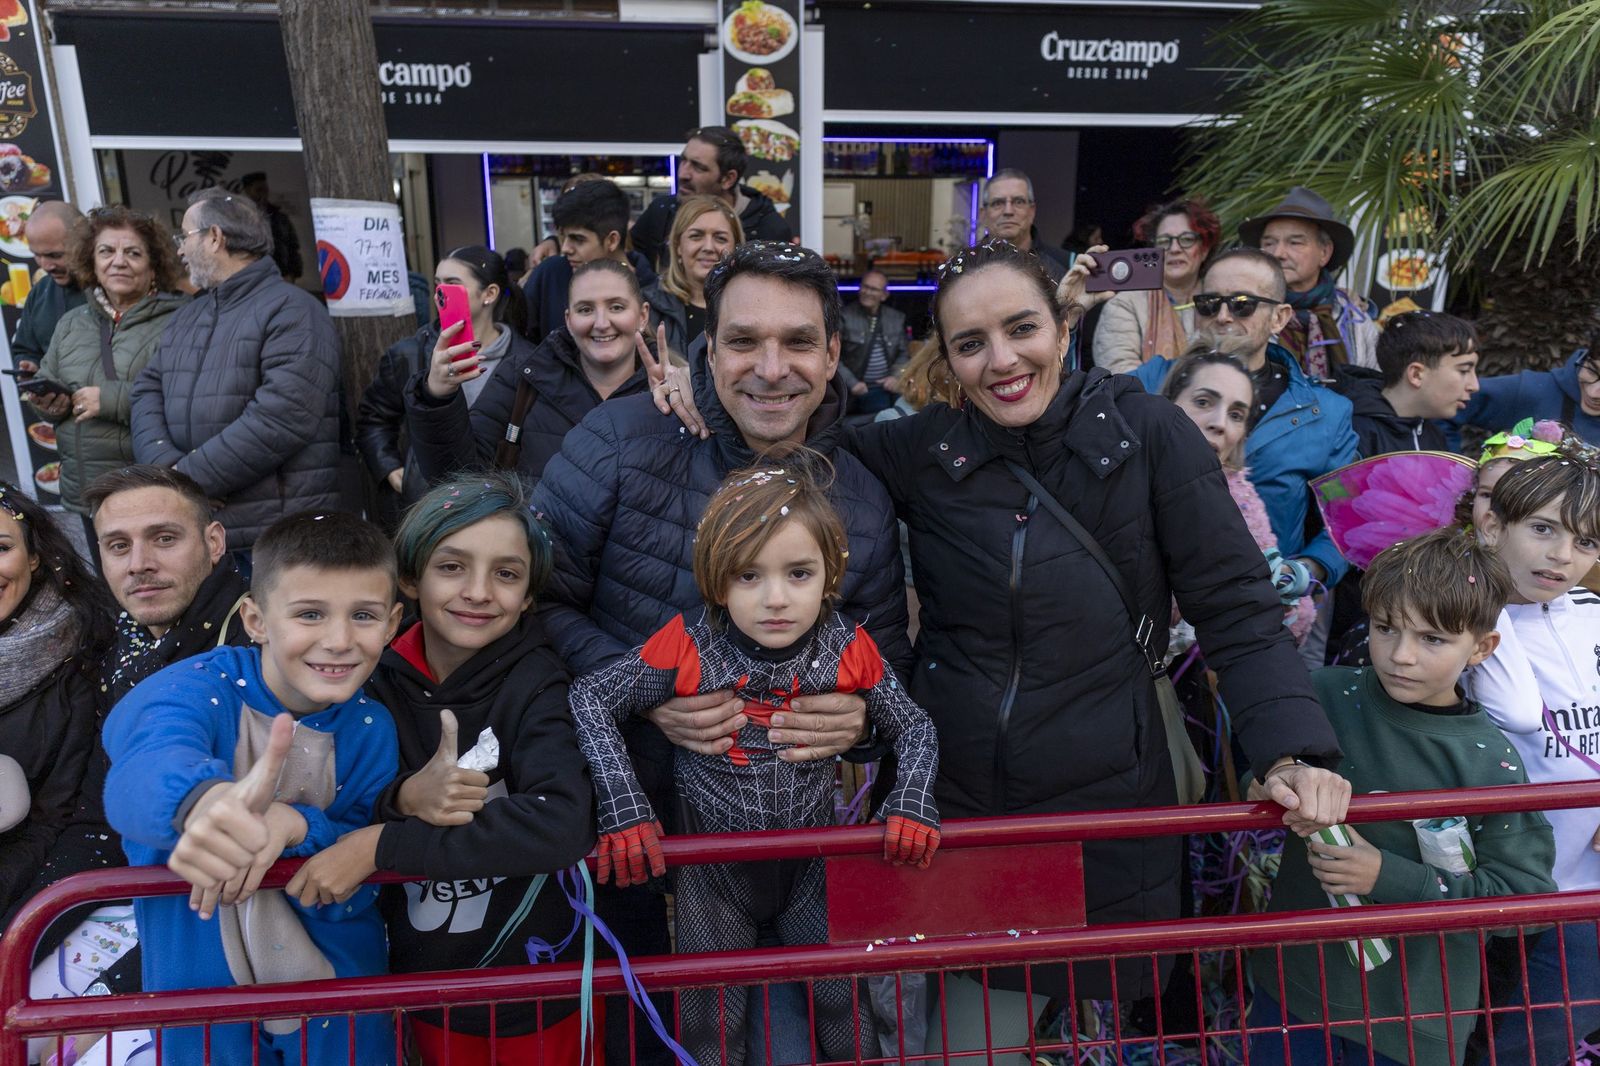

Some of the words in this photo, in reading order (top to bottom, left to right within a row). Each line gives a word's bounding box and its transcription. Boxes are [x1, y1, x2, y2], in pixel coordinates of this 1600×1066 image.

[1041, 31, 1179, 67] Cruzcampo
[378, 60, 471, 91] campo
[1067, 67, 1108, 79] DESDE
[364, 217, 389, 231] DIA
[367, 270, 400, 284] MES
[1544, 735, 1570, 758] FLY
